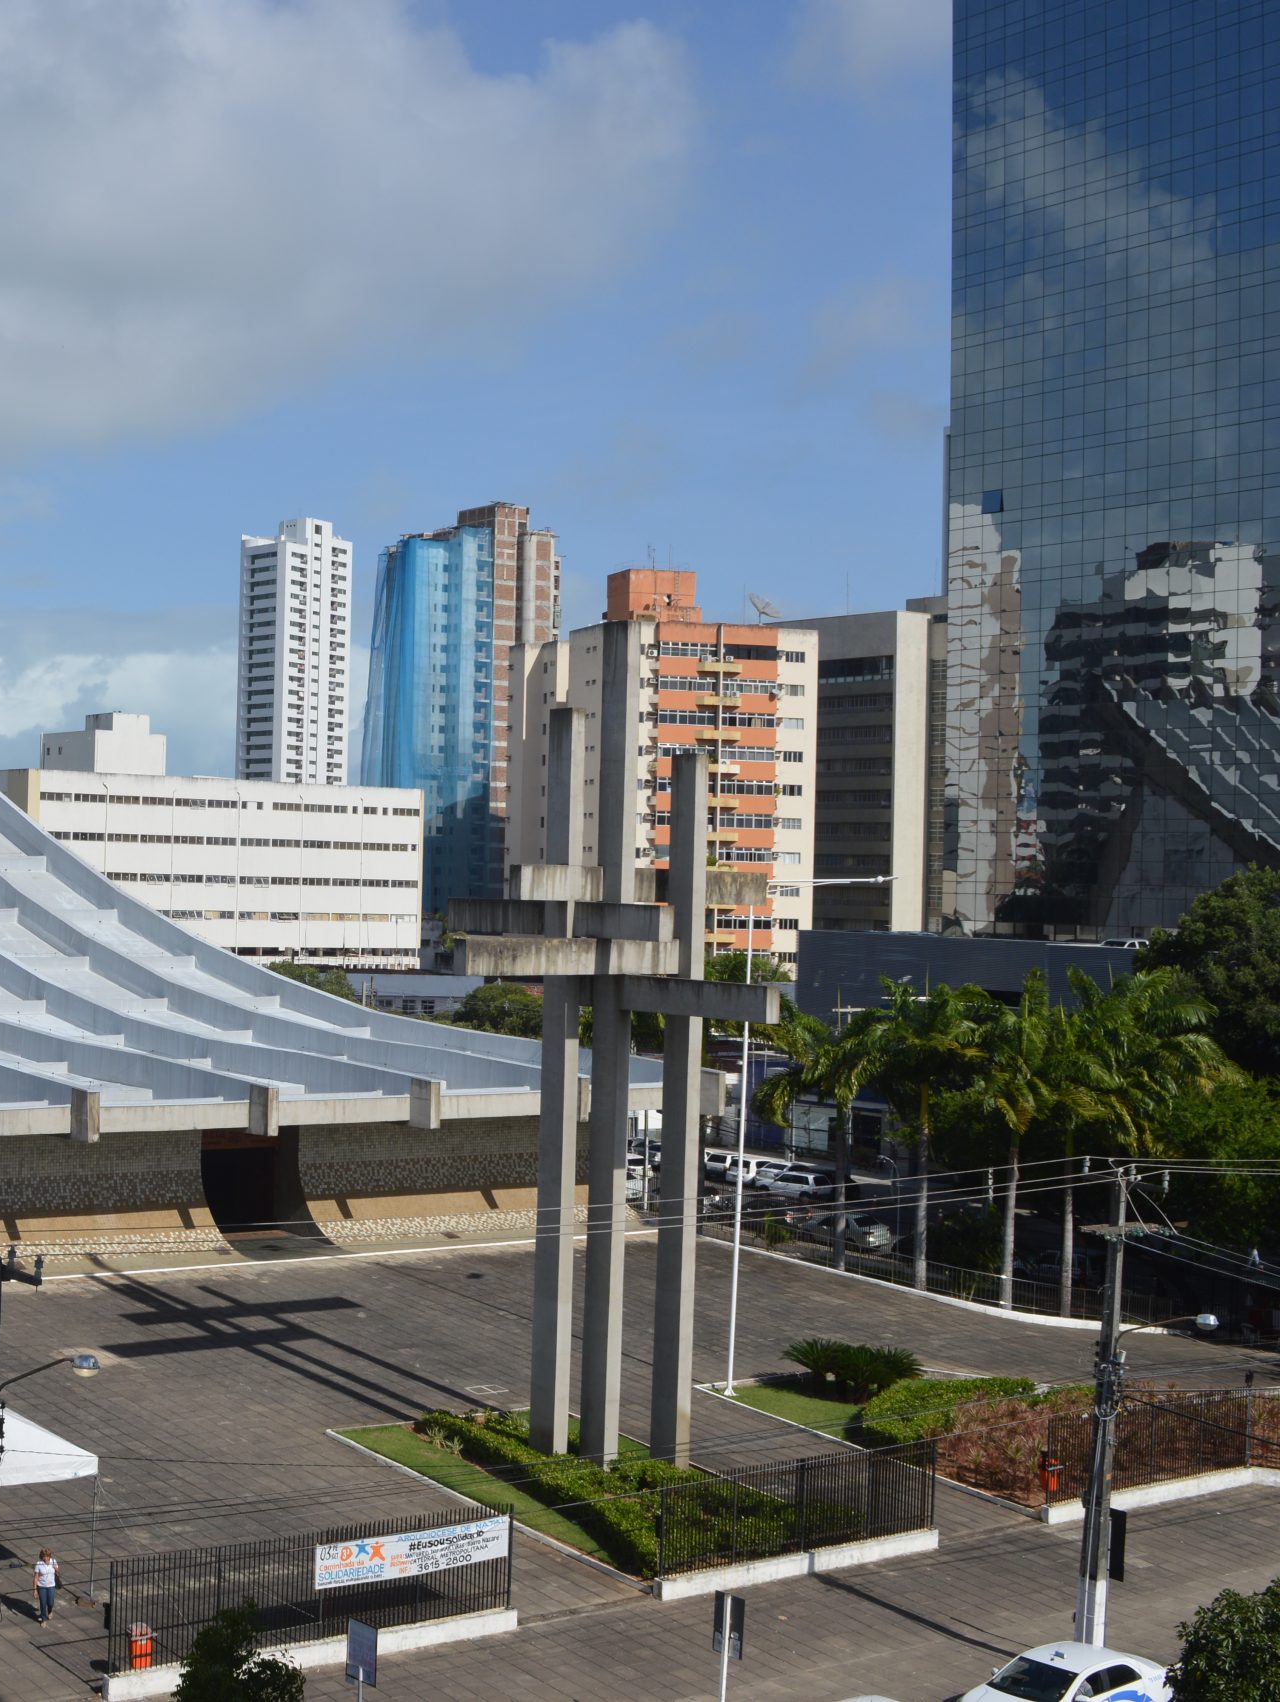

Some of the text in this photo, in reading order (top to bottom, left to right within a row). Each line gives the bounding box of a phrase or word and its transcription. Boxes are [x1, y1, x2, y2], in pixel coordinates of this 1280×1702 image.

[398, 1517, 506, 1542] ARQUIDIOCESE DE NATAL
[320, 1544, 331, 1561] 03
[318, 1563, 385, 1582] SOLIDARIEDADE
[319, 1558, 364, 1572] Caminhada da
